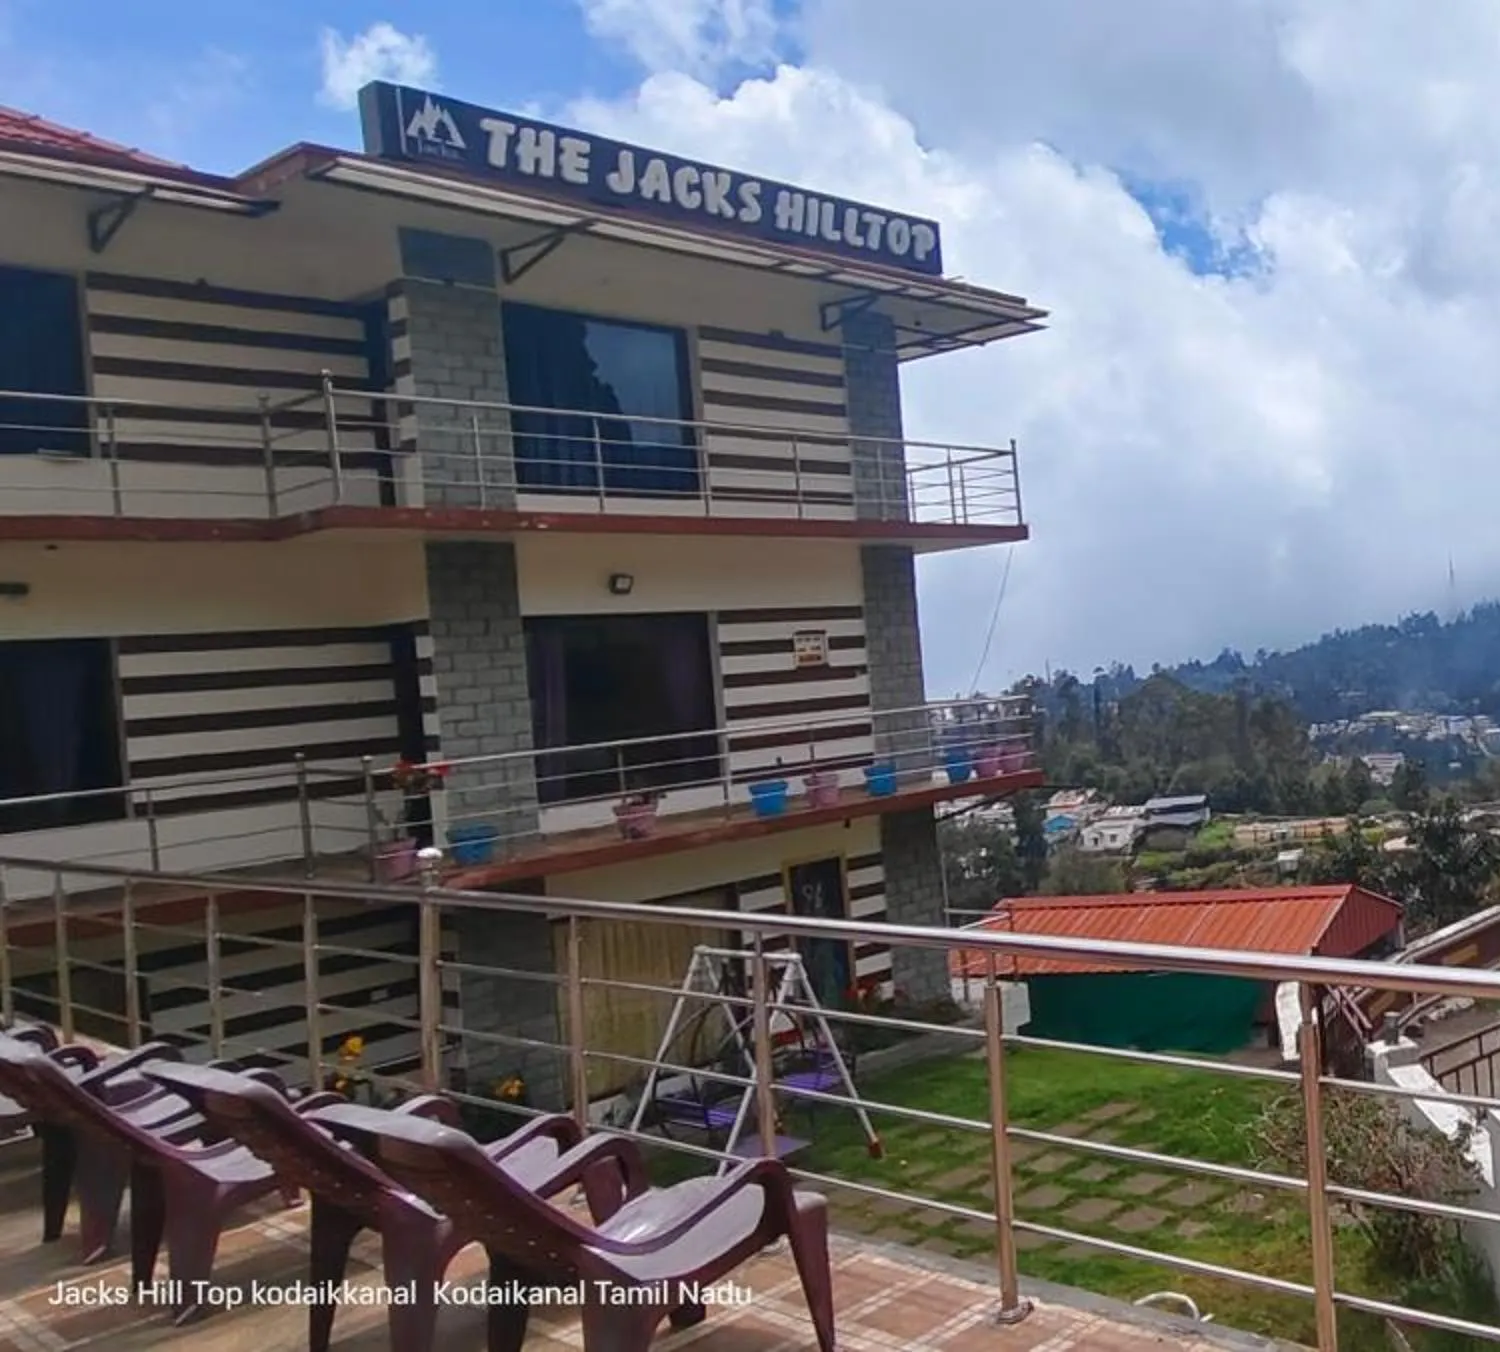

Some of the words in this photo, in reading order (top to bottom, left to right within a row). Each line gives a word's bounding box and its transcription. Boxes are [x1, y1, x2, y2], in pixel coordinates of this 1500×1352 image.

[479, 116, 591, 184] THE
[606, 149, 762, 224] JACKS
[773, 190, 936, 261] HILLTOP
